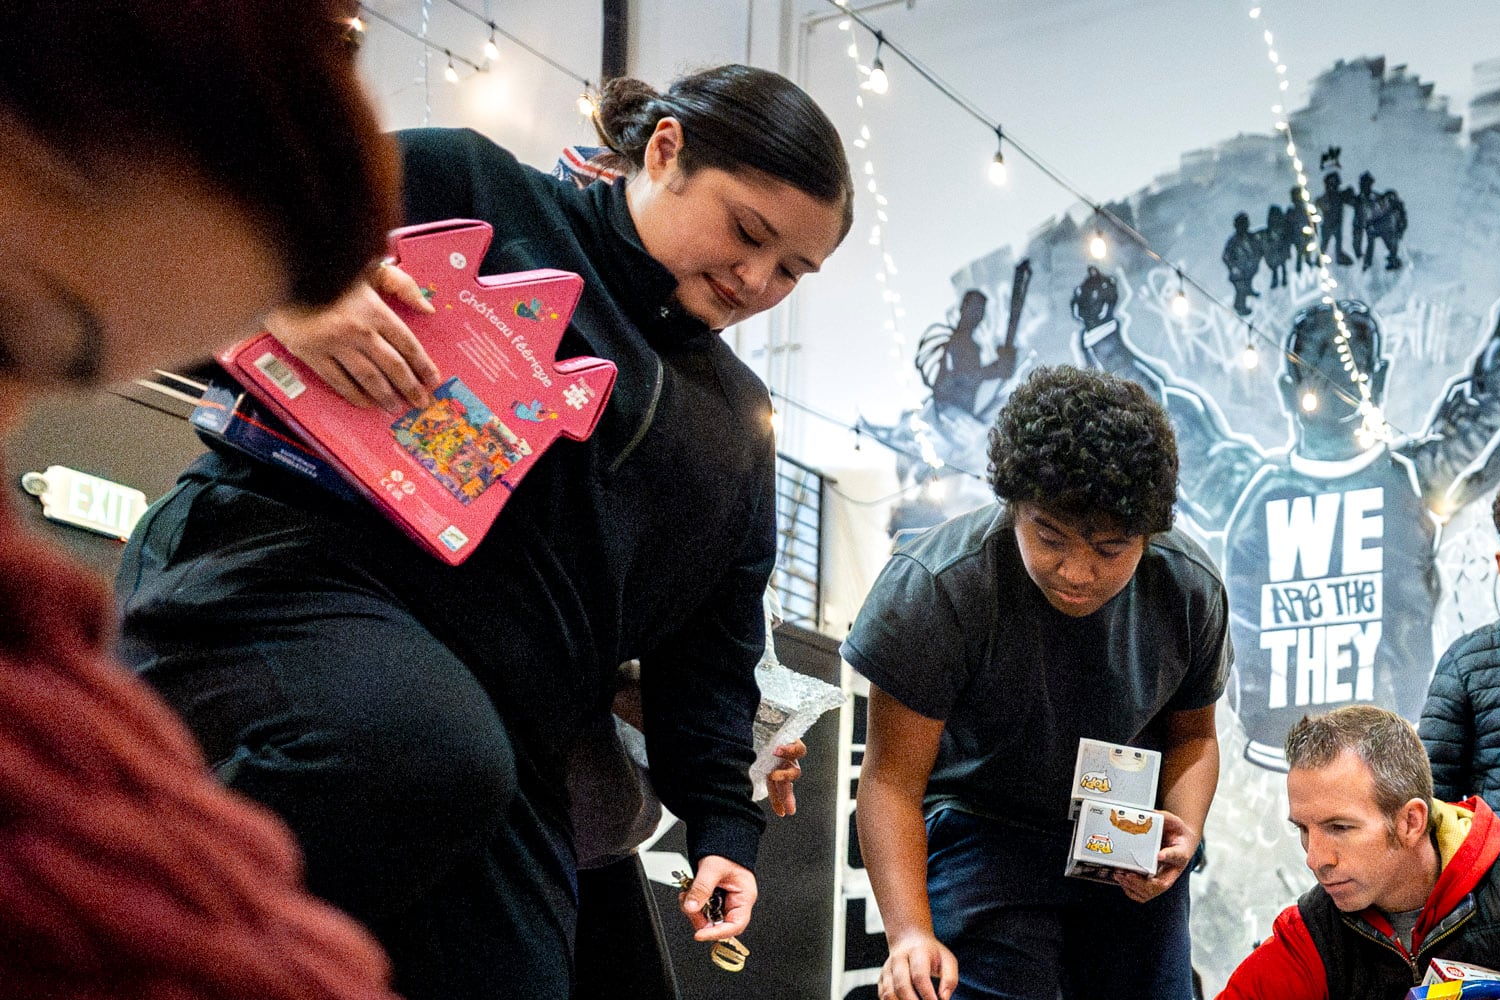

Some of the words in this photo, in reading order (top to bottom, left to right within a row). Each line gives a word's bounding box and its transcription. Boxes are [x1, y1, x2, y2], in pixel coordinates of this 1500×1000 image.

[458, 289, 515, 338] Château
[511, 334, 553, 389] féérique
[69, 478, 132, 532] EXIT
[1265, 486, 1385, 583] WE
[1270, 582, 1323, 624] ARE
[1327, 578, 1377, 618] THE
[1259, 620, 1383, 710] THEY
